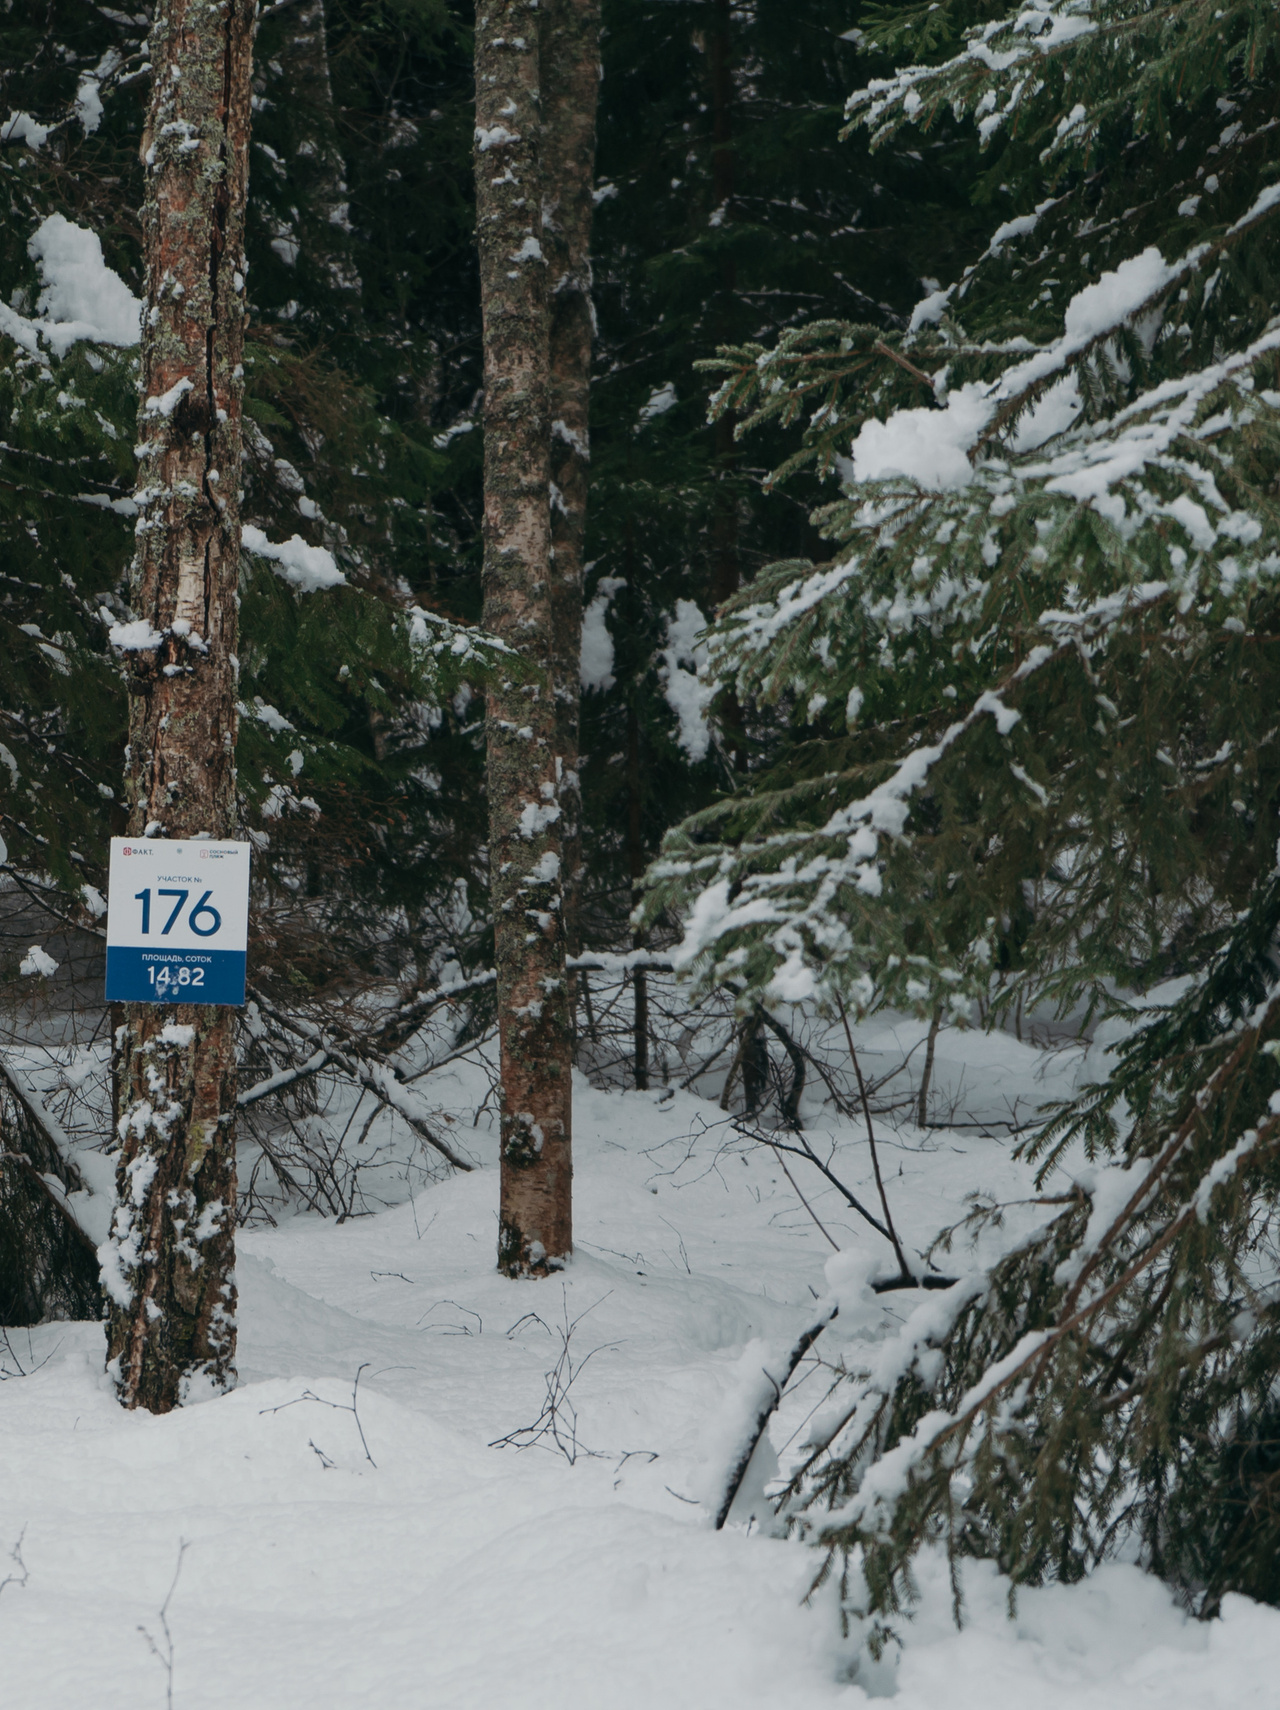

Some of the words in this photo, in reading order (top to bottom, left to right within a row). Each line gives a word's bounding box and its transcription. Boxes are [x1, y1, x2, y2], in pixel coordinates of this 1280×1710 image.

[157, 875, 193, 883] УЧАСТОК
[134, 888, 222, 937] 176
[141, 953, 184, 963] ПЛОЩАДЬ,
[185, 955, 212, 963] СОТОК
[147, 965, 205, 986] 1482
